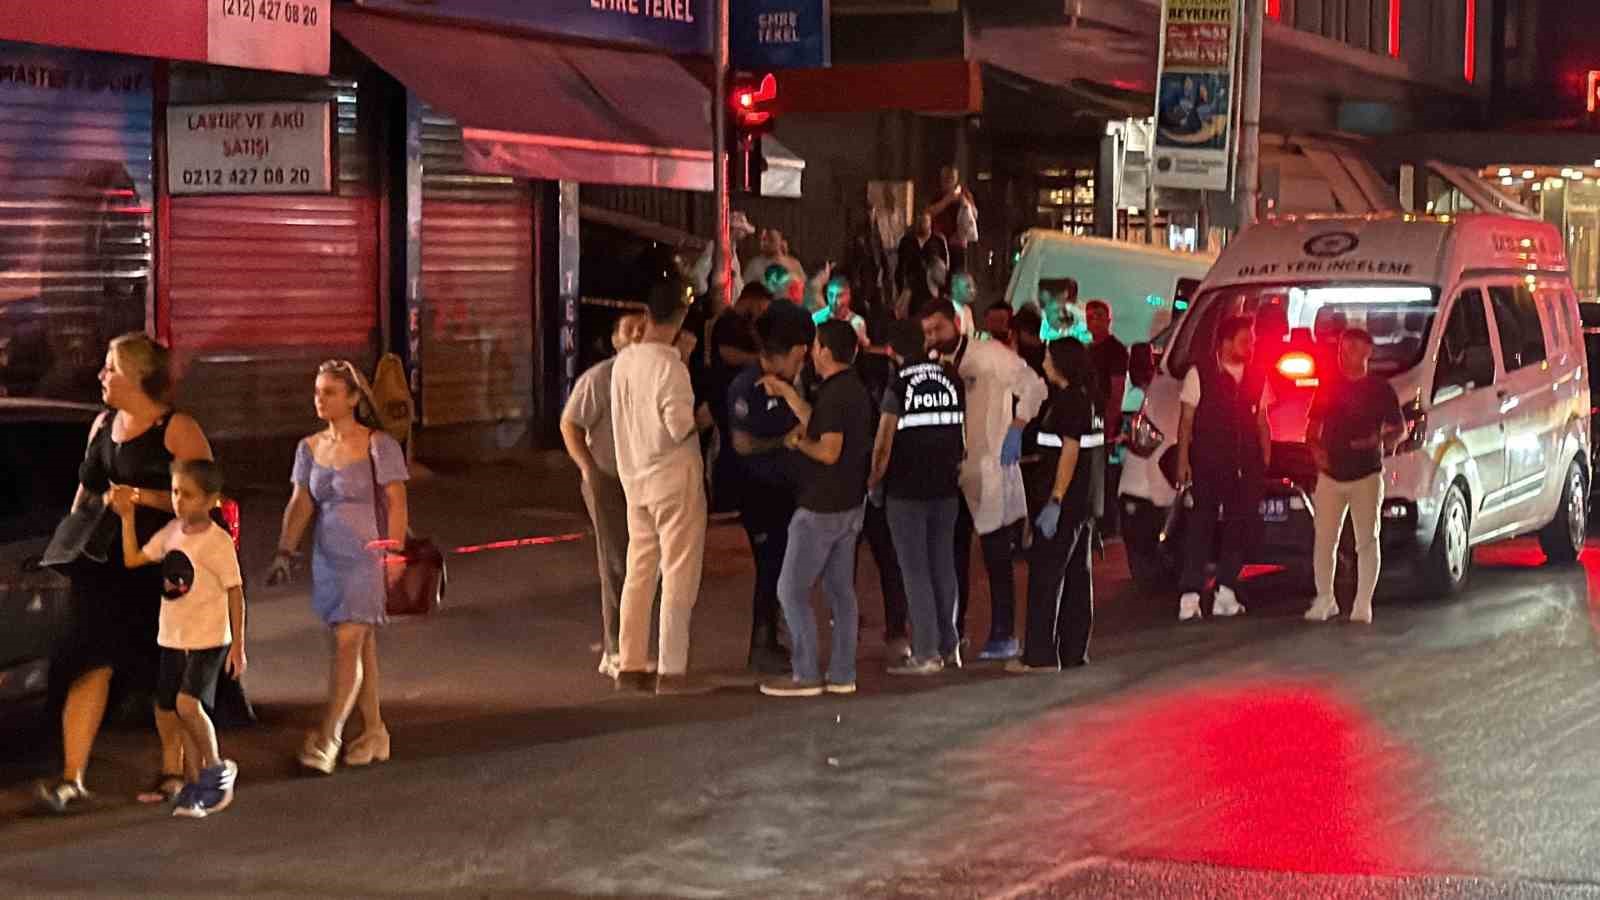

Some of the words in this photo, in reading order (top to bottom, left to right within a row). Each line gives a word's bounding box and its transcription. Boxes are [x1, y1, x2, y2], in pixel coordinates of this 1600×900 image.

[259, 0, 281, 20] 427
[285, 1, 299, 23] 08
[302, 5, 318, 26] 20
[758, 25, 800, 44] TEKEL
[245, 111, 265, 129] VE
[182, 168, 222, 185] 0212
[229, 168, 257, 185] 427
[289, 167, 310, 185] 20
[1238, 264, 1280, 277] OLAY
